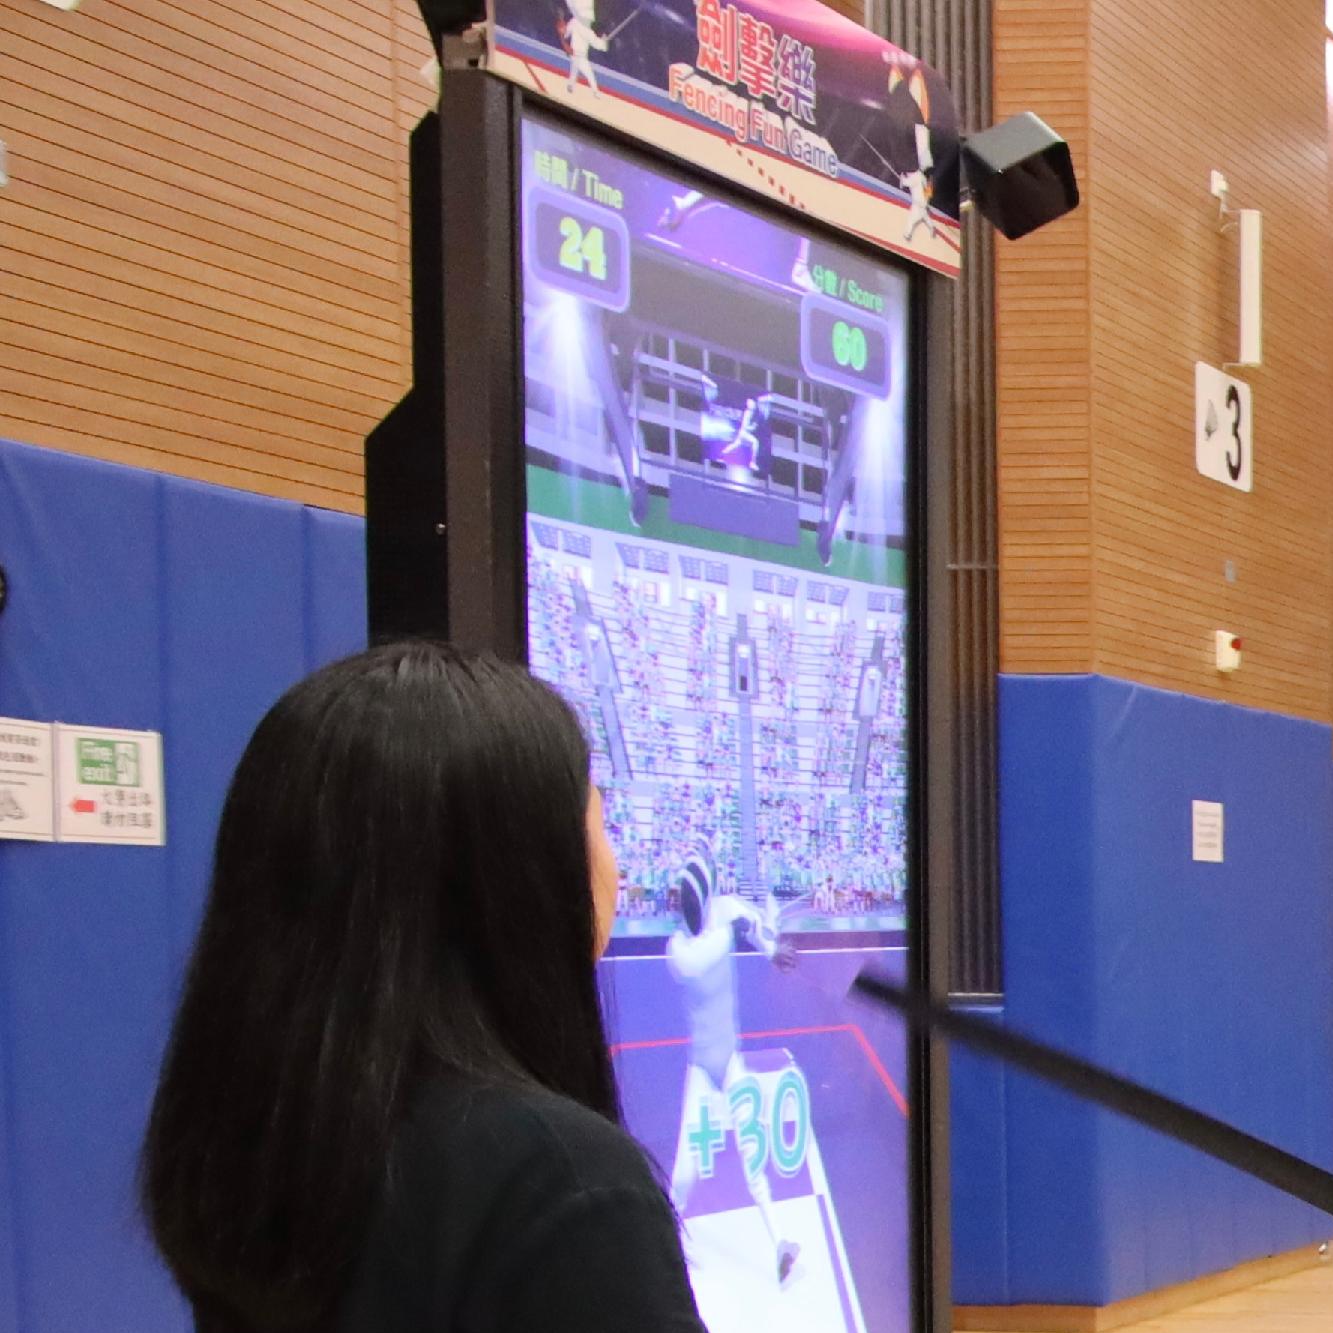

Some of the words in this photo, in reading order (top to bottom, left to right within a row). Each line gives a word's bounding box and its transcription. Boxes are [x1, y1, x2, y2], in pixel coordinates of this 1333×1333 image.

[670, 64, 748, 142] Fencing
[752, 105, 787, 151] Fun
[789, 122, 838, 177] Game
[581, 168, 623, 210] Time
[559, 216, 606, 281] 24
[847, 278, 884, 313] Score
[831, 320, 867, 372] 60
[1225, 383, 1242, 482] 3
